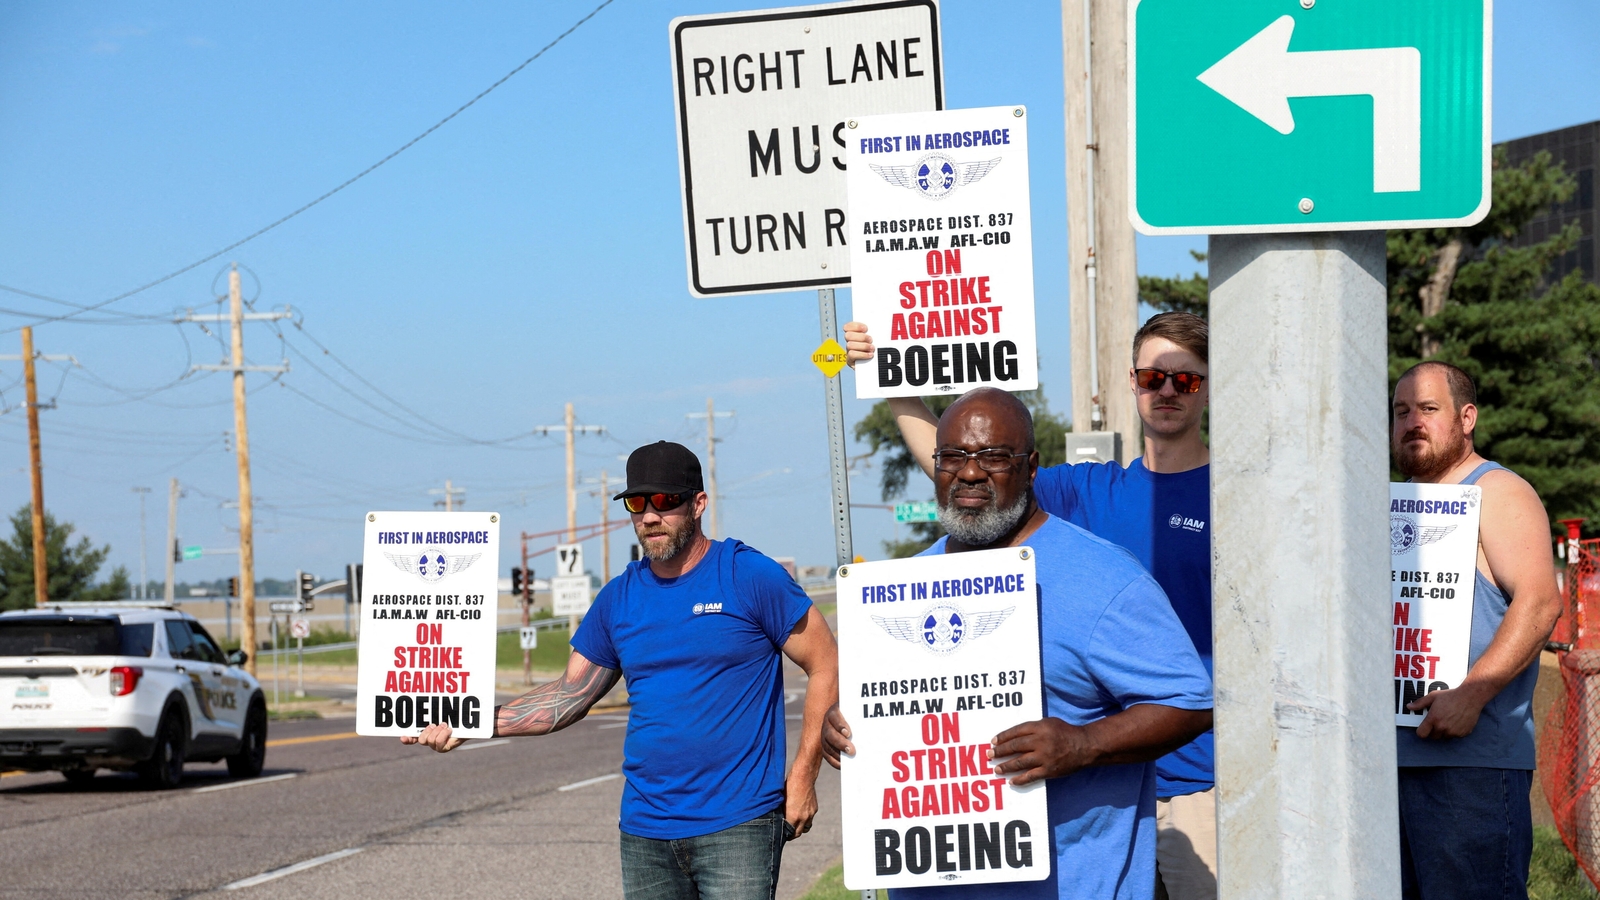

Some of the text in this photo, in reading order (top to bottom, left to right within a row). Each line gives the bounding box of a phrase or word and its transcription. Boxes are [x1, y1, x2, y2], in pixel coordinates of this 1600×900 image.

[694, 38, 923, 96] RIGHT LANE
[748, 122, 846, 177] MUS
[860, 129, 1009, 154] FIRST IN AEROSPACE
[706, 212, 806, 255] TURN
[864, 213, 1012, 234] AEROSPACE DIST. 837
[866, 232, 1010, 252] I.A.M.A.W AFL-CIO
[926, 249, 961, 278] ON
[899, 276, 991, 309] STRIKE
[891, 305, 1002, 340] AGAINST
[813, 354, 847, 362] UTILTIES
[878, 340, 1018, 387] BOEING
[1391, 499, 1467, 515] AEROSPACE
[1183, 518, 1205, 529] IAM
[378, 531, 488, 545] FIRST IN AEROSPACE
[862, 574, 1024, 604] FIRST IN AEROSPACE
[1401, 571, 1431, 583] DIST.
[1437, 572, 1459, 583] 837
[373, 595, 483, 605] AEROSPACE DIST. 837
[1400, 587, 1455, 599] AFL-CIO
[374, 609, 480, 619] I.A.M.A.W AFL-CIO
[1393, 602, 1409, 625] N
[416, 623, 442, 645] ON
[1394, 628, 1432, 652] IKE
[394, 646, 462, 668] STRIKE
[385, 671, 470, 693] AGAINST
[862, 671, 1025, 697] AEROSPACE DIST. 837
[375, 696, 480, 729] BOEING
[864, 692, 1022, 718] I.A.M.A.W AFL-CIO
[922, 712, 960, 746] ON
[892, 744, 993, 783] STRIKE
[882, 778, 1006, 819] AGAINST
[875, 820, 1032, 877] BOEING
